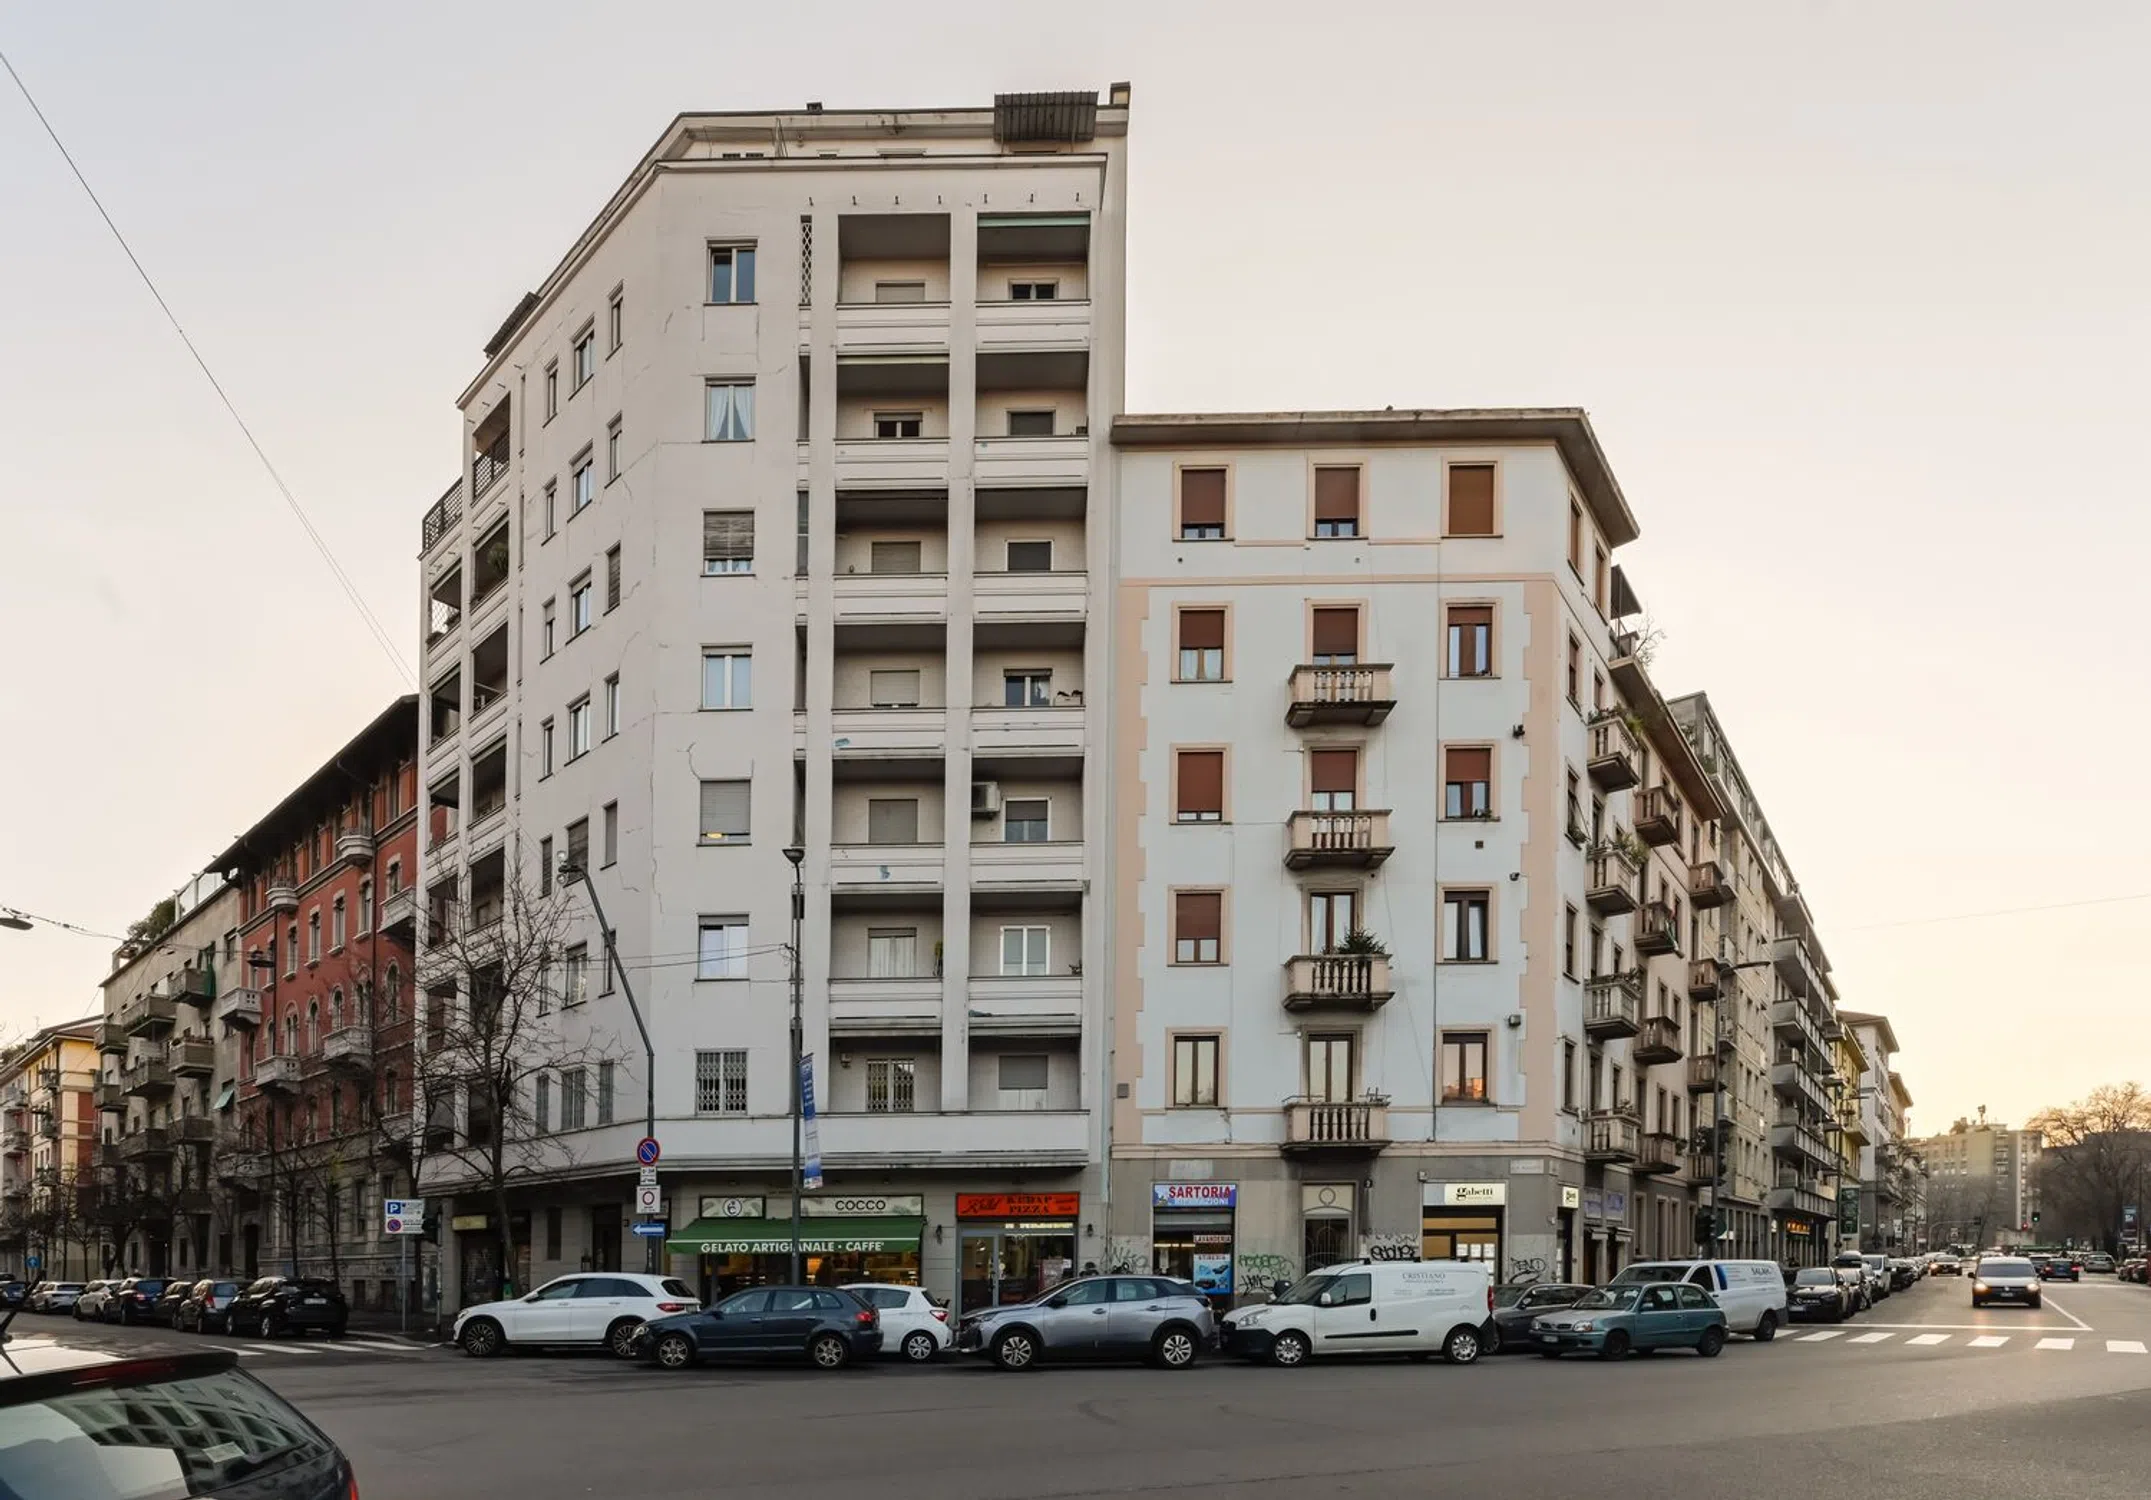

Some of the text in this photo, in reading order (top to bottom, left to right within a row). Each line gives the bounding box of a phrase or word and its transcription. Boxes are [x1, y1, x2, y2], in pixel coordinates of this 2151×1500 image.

[1168, 1185, 1232, 1198] SARTORIA
[1456, 1186, 1493, 1201] gabetti
[390, 1203, 399, 1213] P
[834, 1200, 886, 1211] COCCO
[1009, 1204, 1050, 1213] PIZZA
[701, 1243, 749, 1253] GELATO
